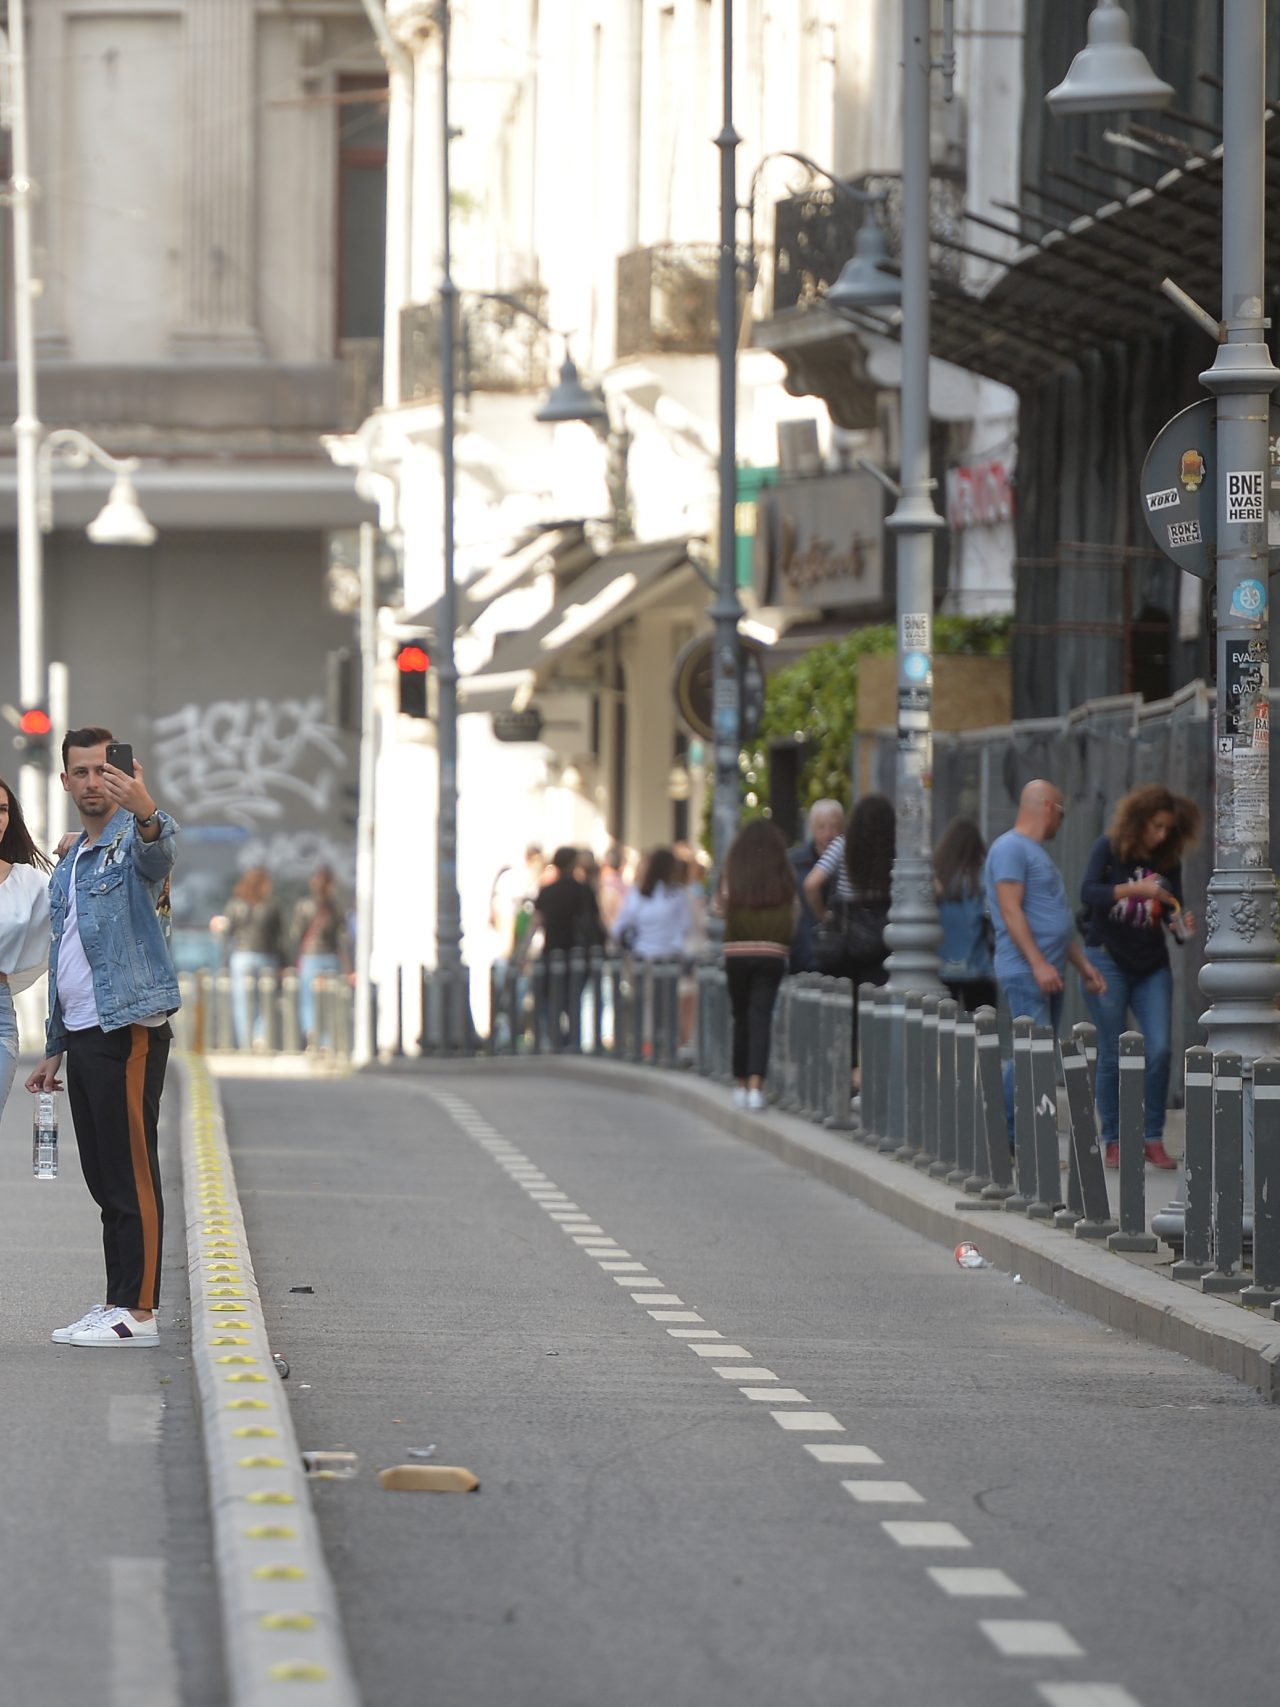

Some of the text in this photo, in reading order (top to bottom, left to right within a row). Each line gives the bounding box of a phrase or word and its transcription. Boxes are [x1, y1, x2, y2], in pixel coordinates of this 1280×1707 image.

[1229, 475, 1262, 495] BNE
[1150, 493, 1177, 507] KOKO
[1230, 497, 1262, 507] WAS
[1229, 509, 1262, 520] HERE
[1170, 522, 1198, 537] RON'S
[1172, 534, 1200, 544] CREW
